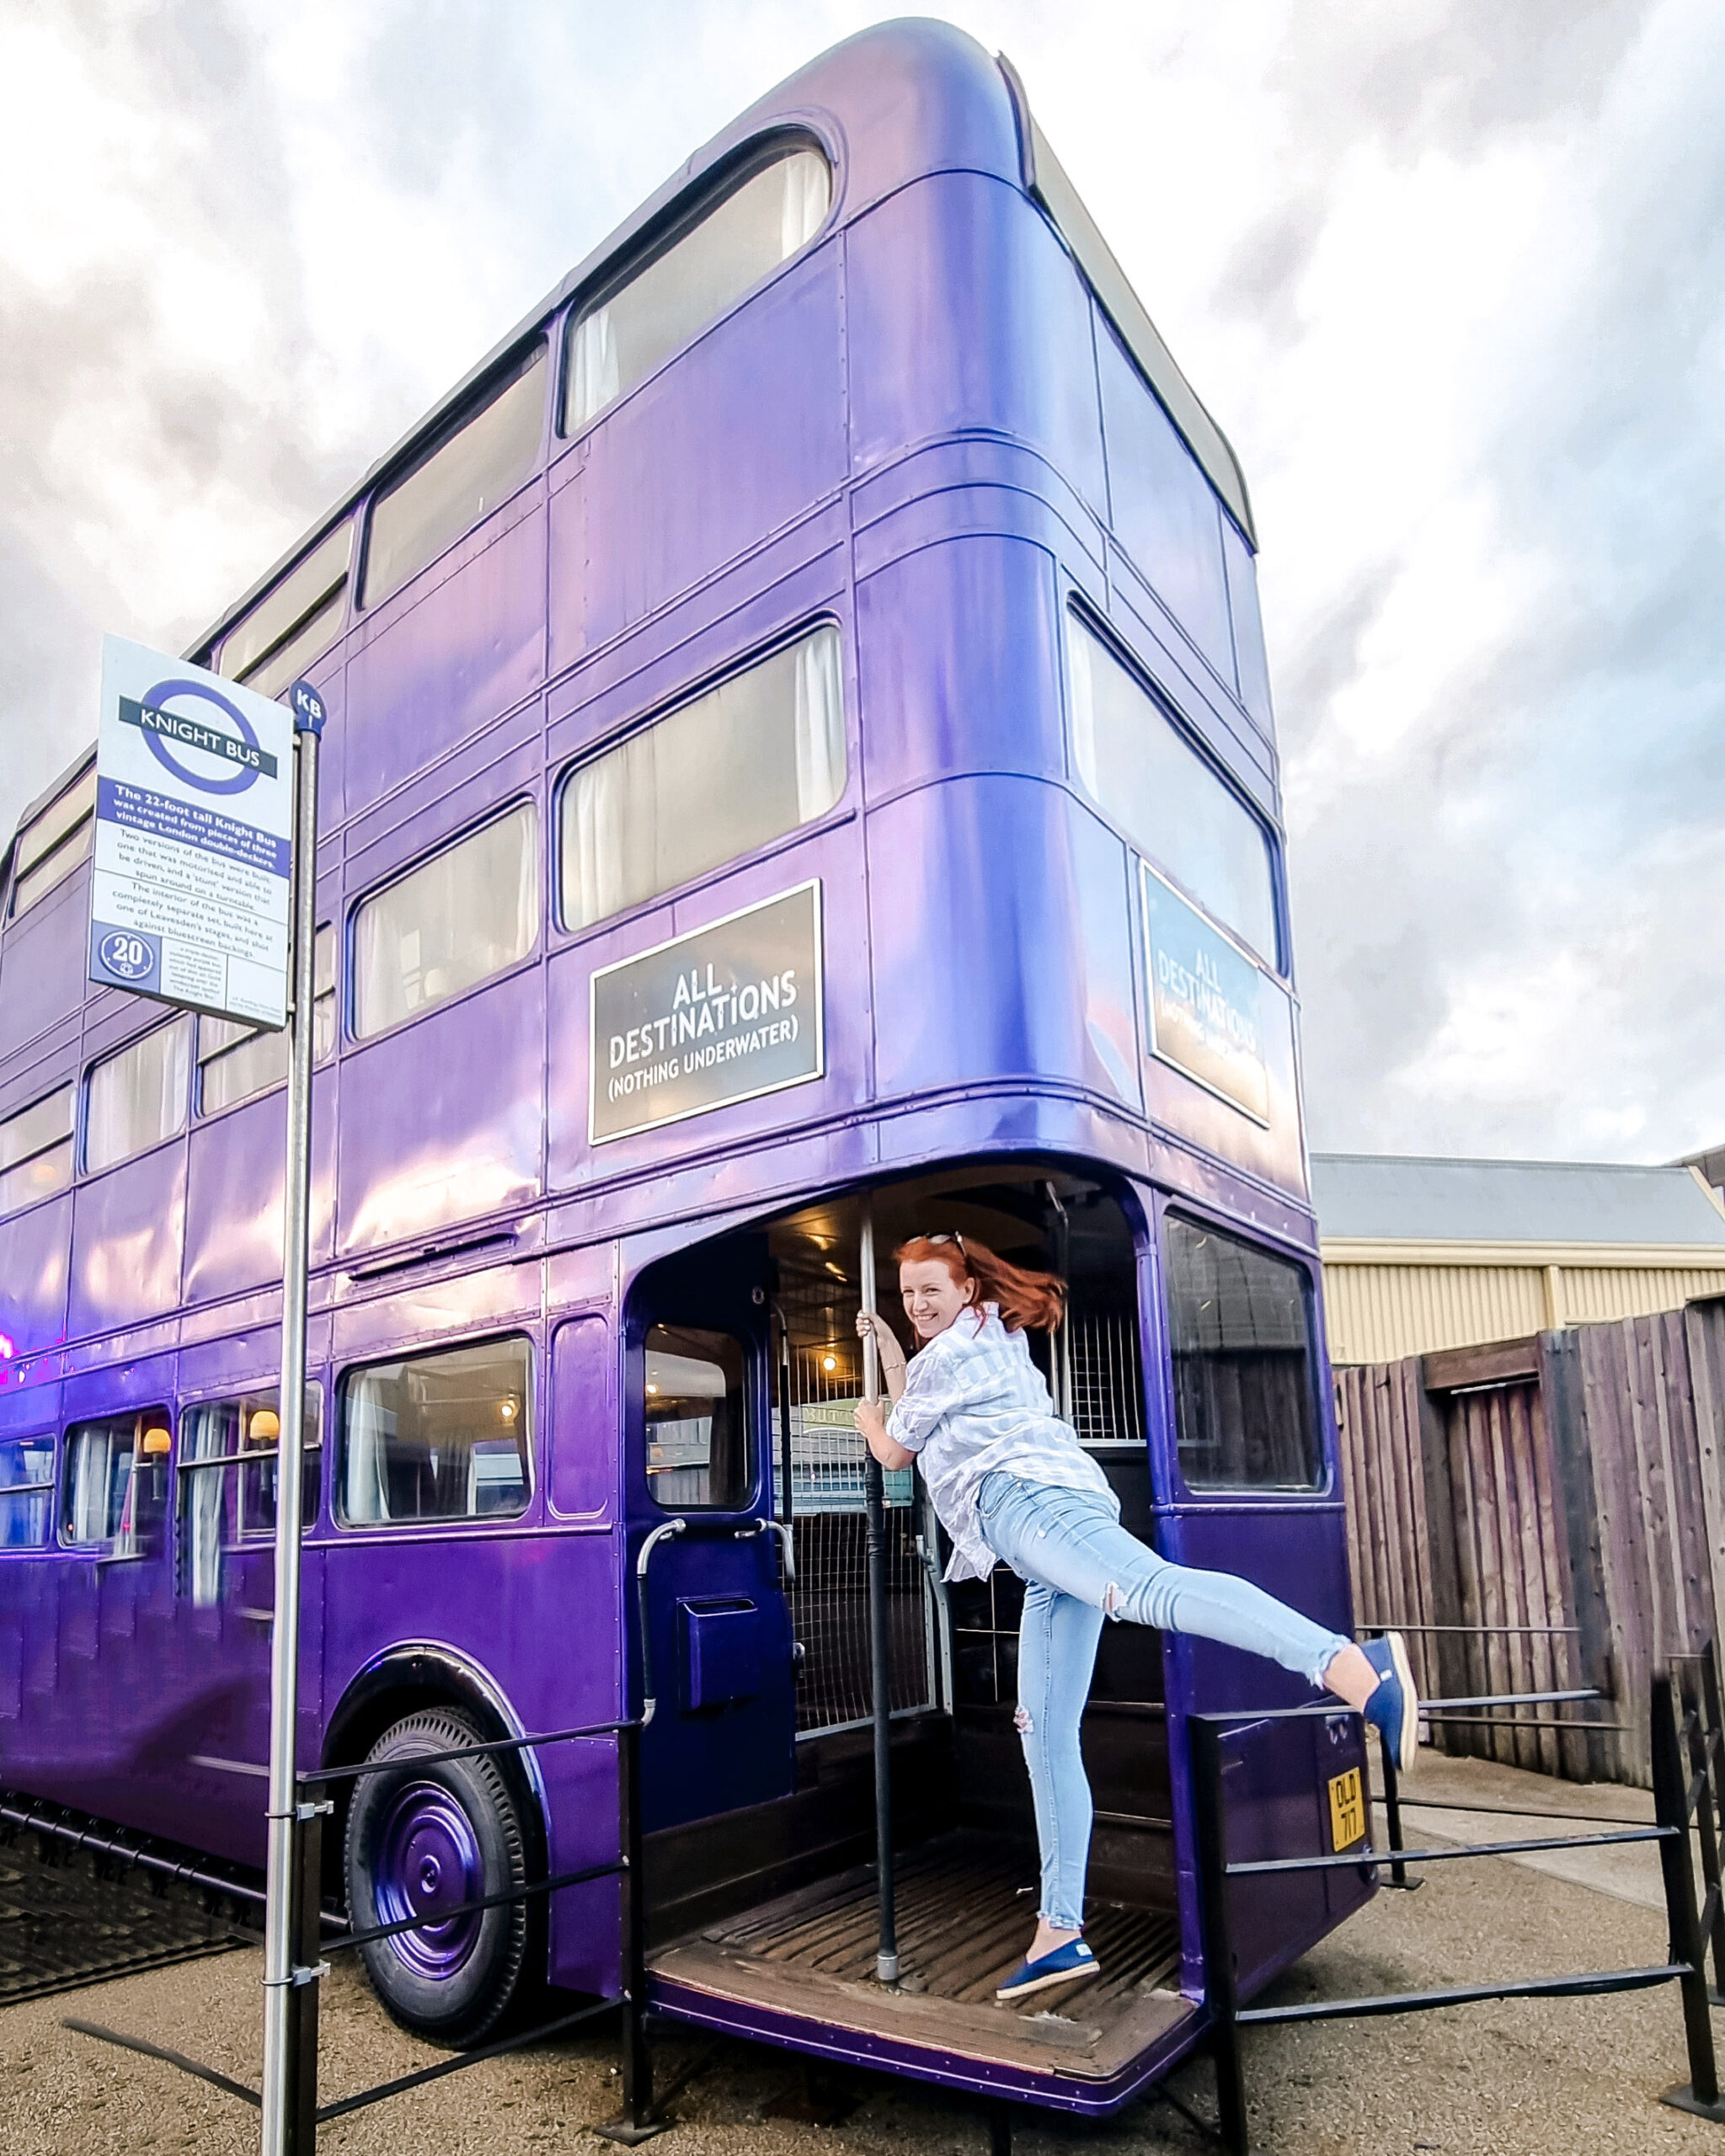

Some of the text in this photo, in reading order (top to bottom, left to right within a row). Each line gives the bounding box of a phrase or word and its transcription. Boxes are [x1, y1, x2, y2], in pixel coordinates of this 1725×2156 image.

[296, 688, 322, 719] KB
[141, 709, 260, 767] KNIGHT BUS
[113, 798, 277, 857] was created from pieces of three
[114, 783, 276, 847] The 22-foot tall Knight Bus
[115, 808, 155, 830] vintage
[158, 822, 198, 841] London
[116, 841, 135, 851] one
[138, 846, 157, 857] that
[159, 853, 177, 863] was
[227, 873, 243, 883] and
[120, 829, 140, 841] Two
[142, 836, 180, 852] versions
[183, 847, 192, 856] of
[194, 851, 208, 862] the
[211, 857, 226, 867] bus
[118, 852, 131, 862] be
[167, 866, 183, 877] and
[221, 883, 252, 898] version
[254, 894, 270, 904] that
[135, 869, 157, 883] spun
[160, 876, 192, 890] around
[111, 888, 163, 910] completely
[166, 905, 204, 922] separate
[222, 921, 242, 931] built
[243, 926, 263, 937] here
[131, 882, 150, 893] The
[152, 888, 187, 903] interior
[201, 902, 215, 911] the
[218, 906, 232, 916] bus
[236, 914, 251, 922] was
[115, 903, 134, 913] one
[136, 906, 147, 915] of
[234, 935, 248, 945] and
[251, 940, 269, 952] shot
[133, 917, 165, 933] against
[167, 926, 215, 946] bluescreen
[113, 937, 143, 965] 20
[1194, 947, 1222, 993] ALL
[673, 963, 723, 1011] ALL
[609, 969, 798, 1070] DESTINATIONS
[607, 1014, 798, 1102] (NOTHING UNDERWATER)
[1336, 1774, 1356, 1808] OLD
